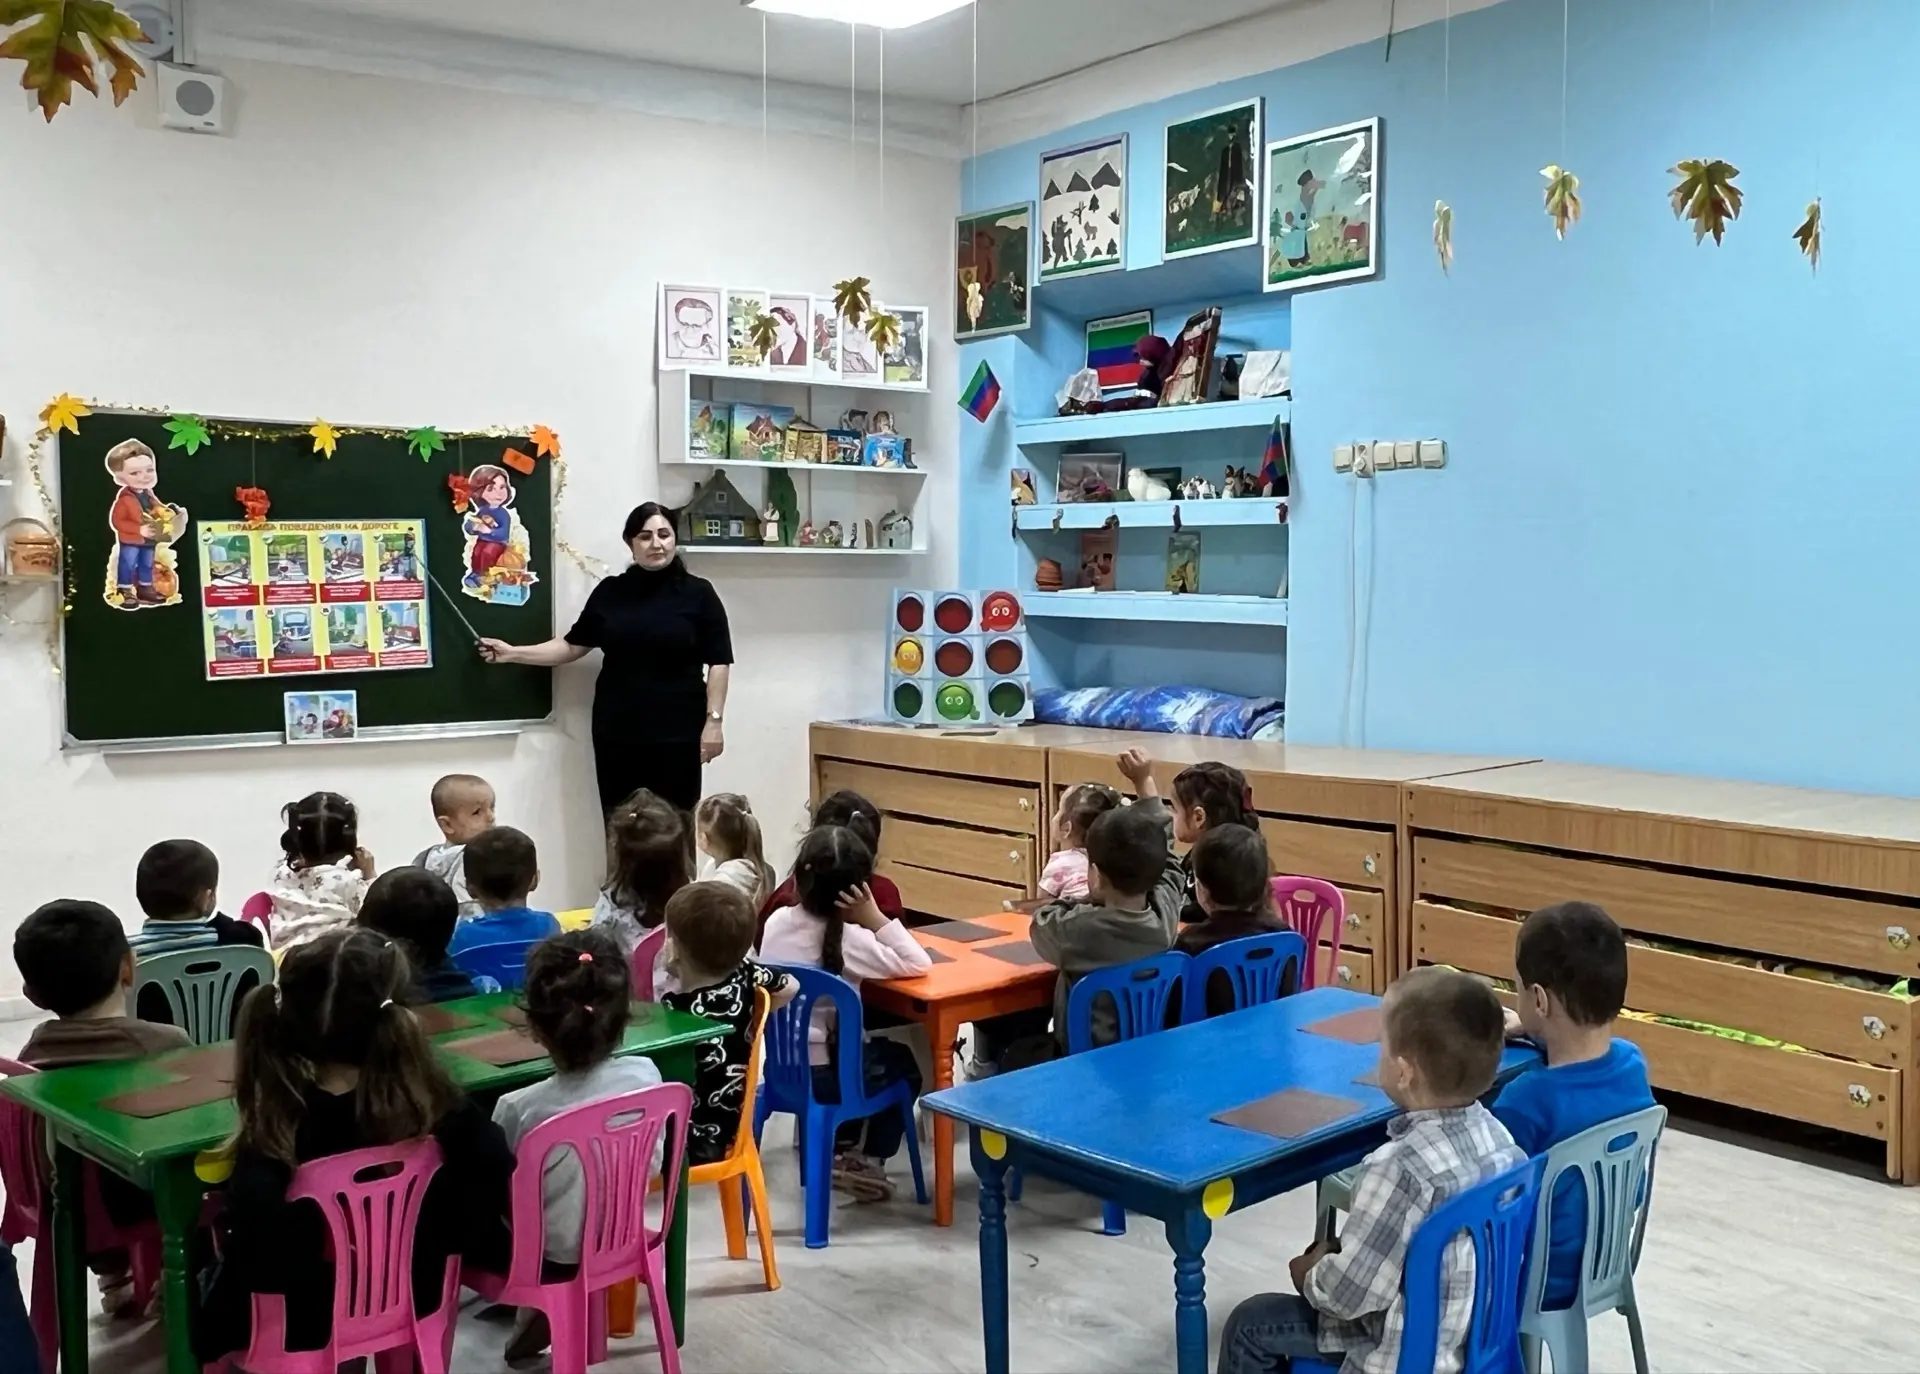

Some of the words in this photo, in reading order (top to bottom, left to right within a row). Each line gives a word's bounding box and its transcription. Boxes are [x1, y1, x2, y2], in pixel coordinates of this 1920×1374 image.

[279, 523, 340, 532] ПОВЕДЕНИЯ
[344, 522, 358, 530] НА
[361, 522, 399, 531] ДОРОГЕ
